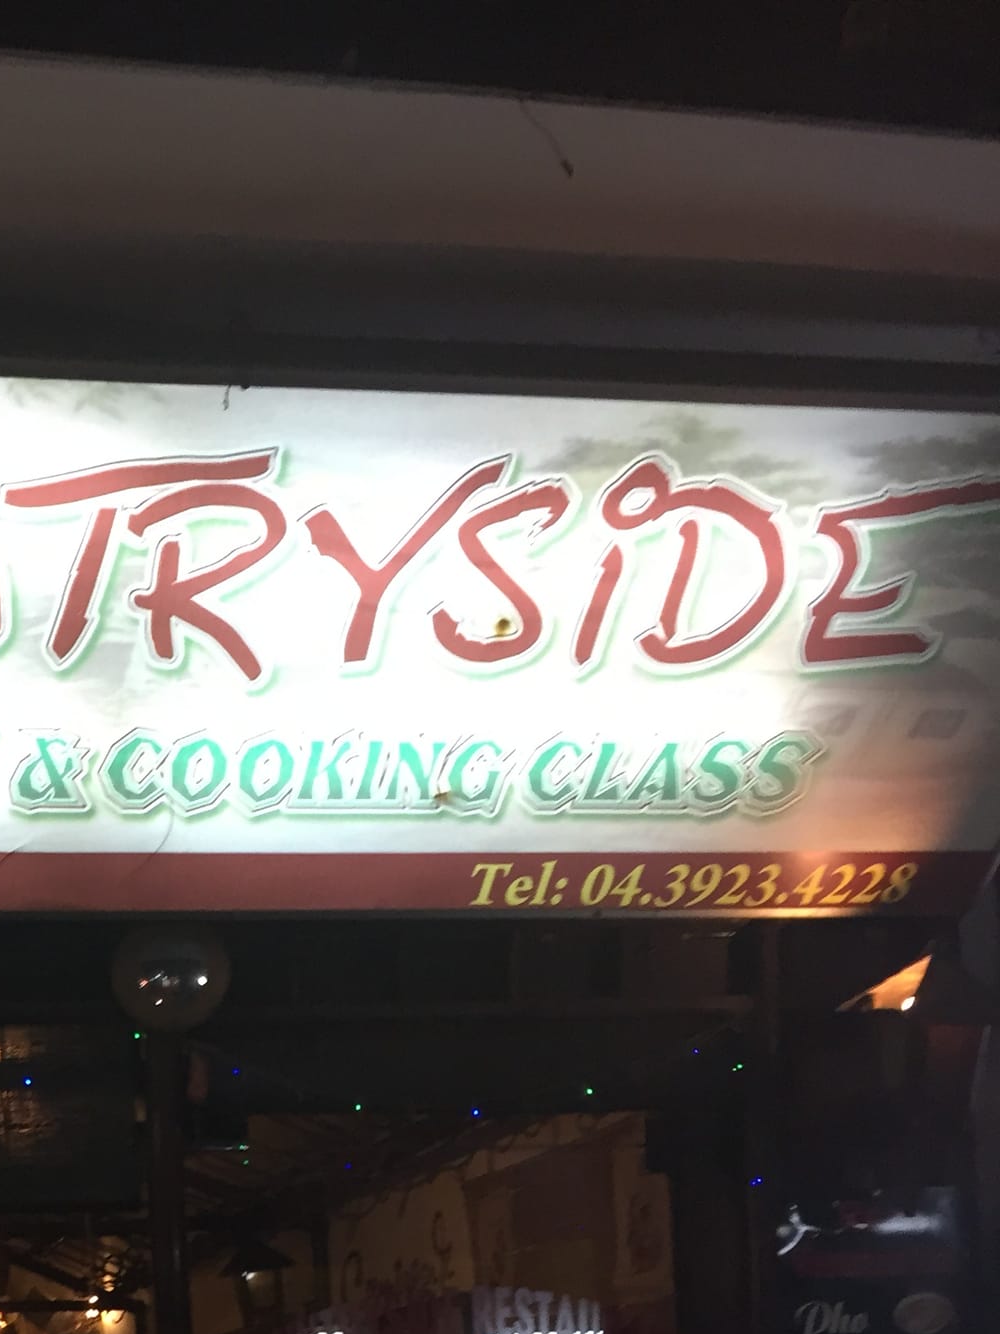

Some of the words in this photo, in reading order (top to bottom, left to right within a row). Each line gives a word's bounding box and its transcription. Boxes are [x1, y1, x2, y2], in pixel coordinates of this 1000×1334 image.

[18, 730, 88, 812] &
[100, 728, 512, 815] COOKING
[519, 730, 824, 815] CLASS
[470, 863, 563, 907] Tel:
[579, 861, 918, 908] 04.3923.4228
